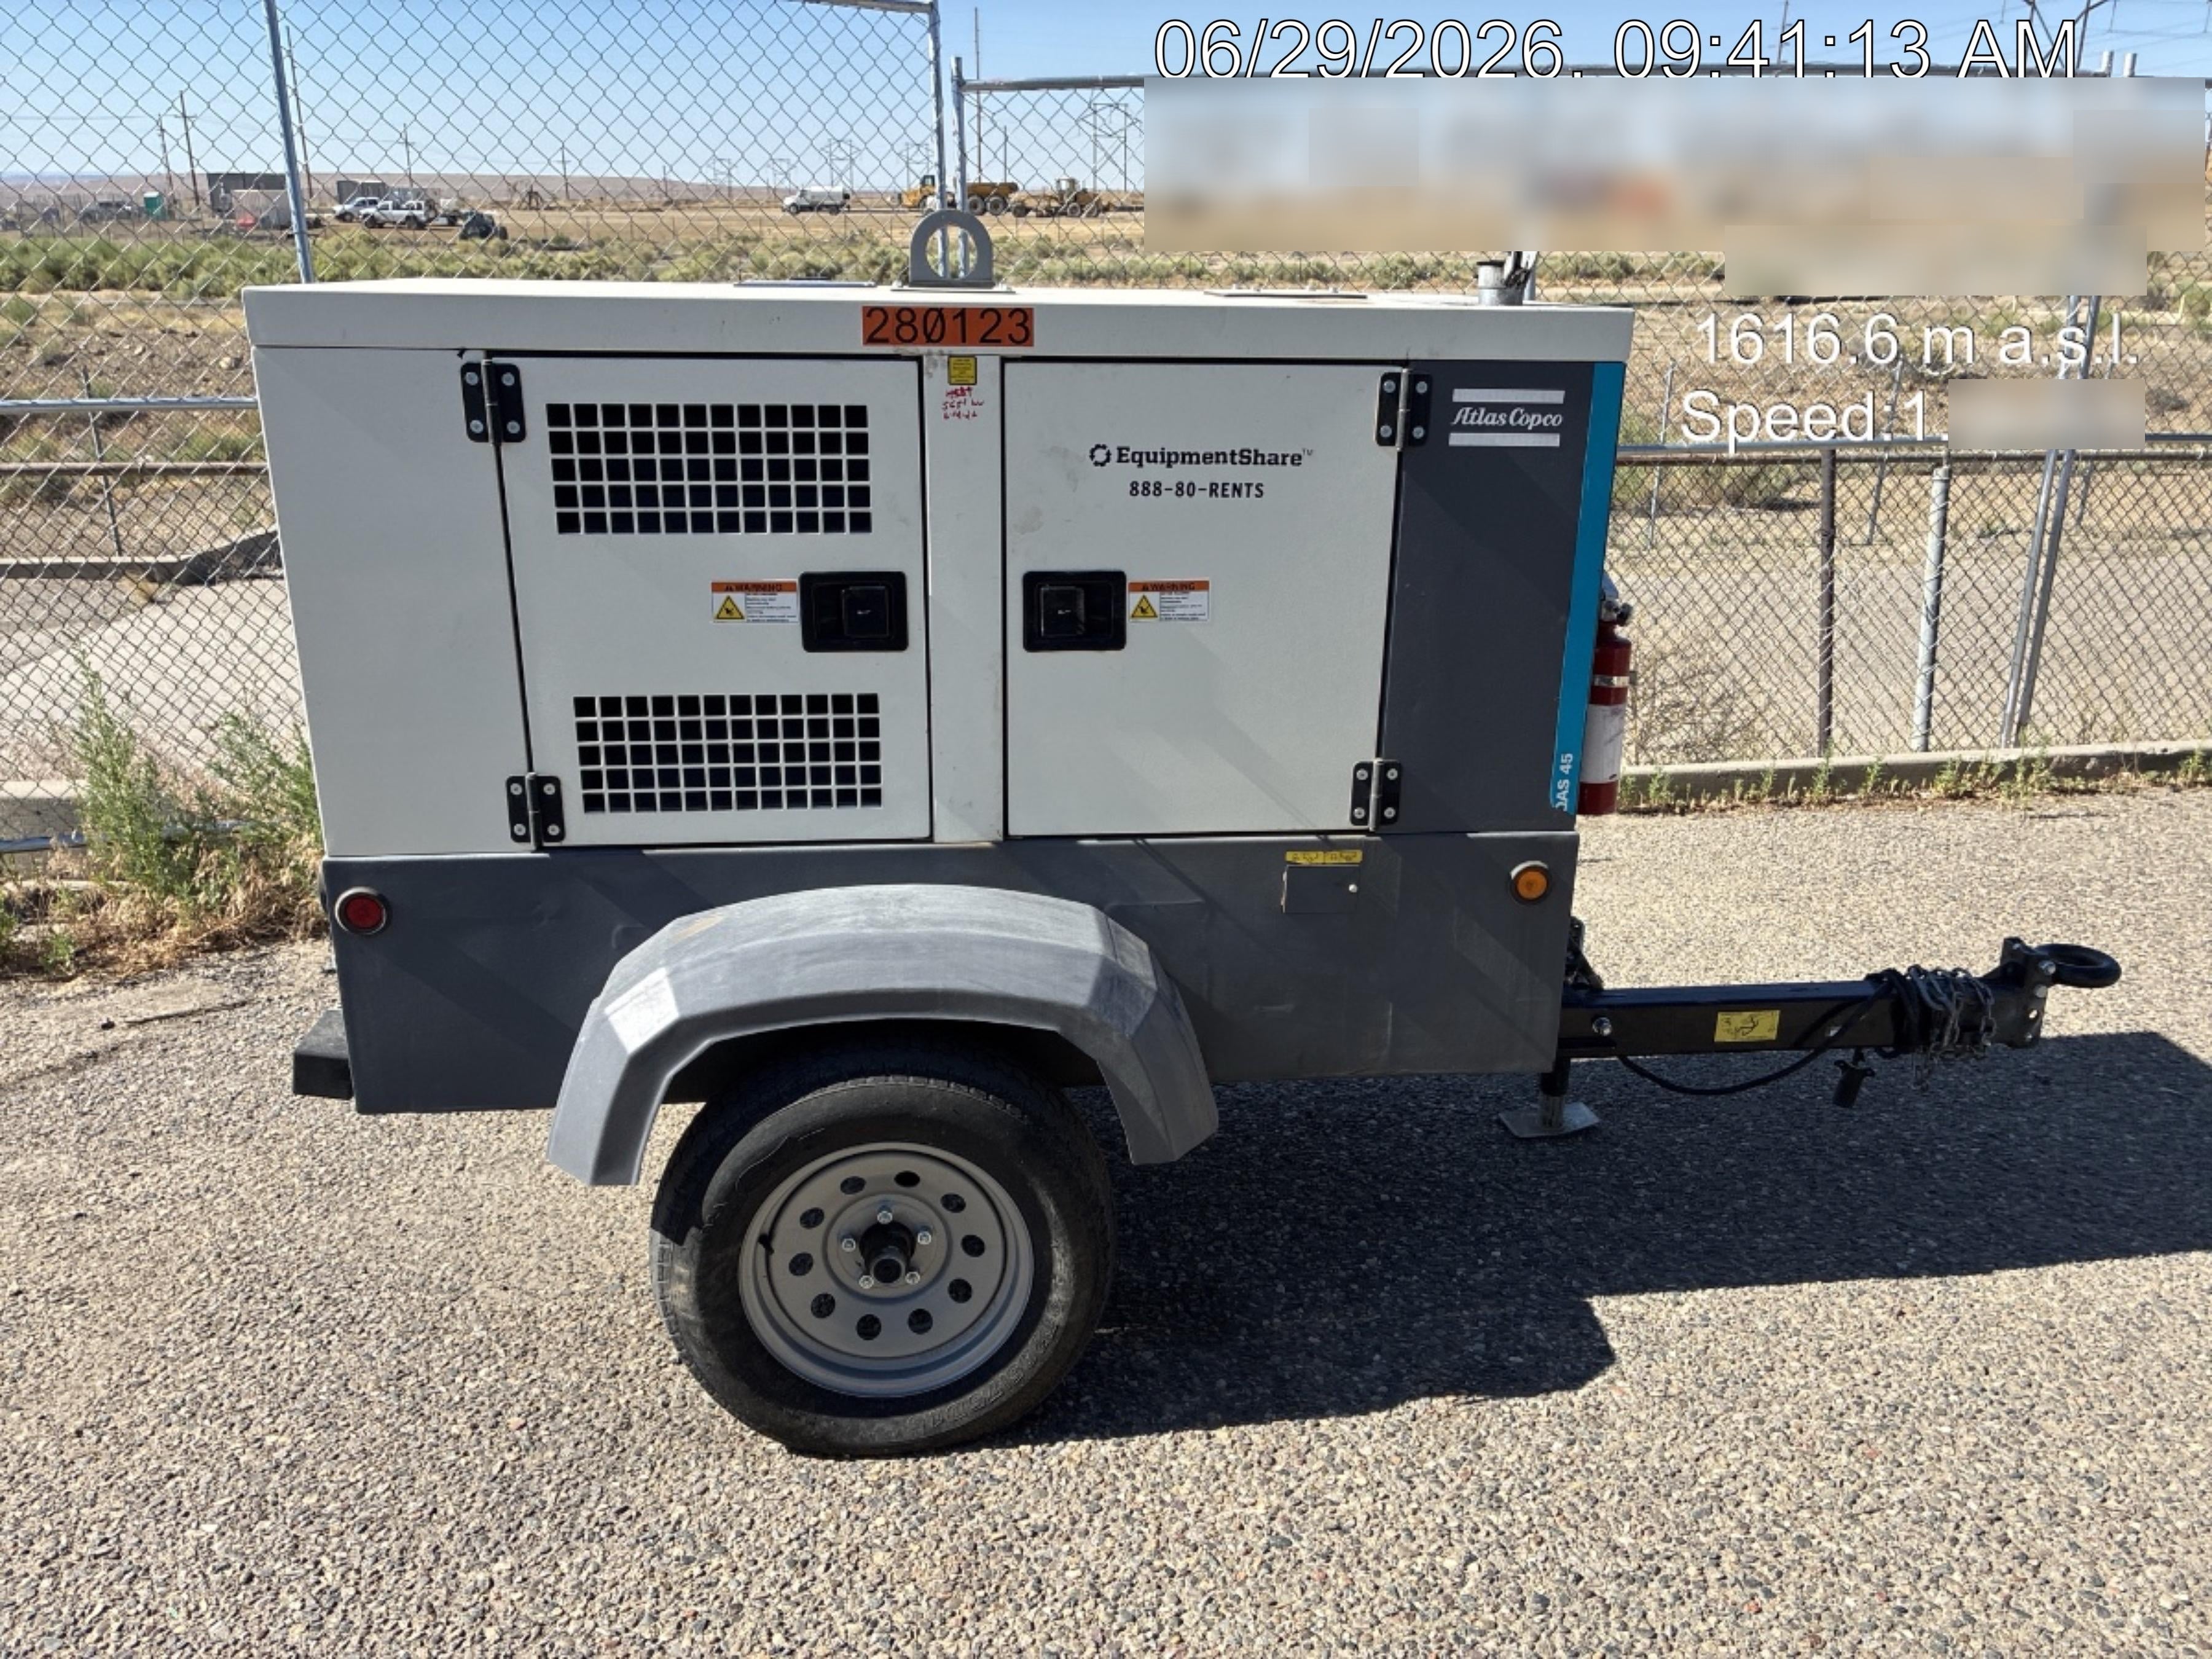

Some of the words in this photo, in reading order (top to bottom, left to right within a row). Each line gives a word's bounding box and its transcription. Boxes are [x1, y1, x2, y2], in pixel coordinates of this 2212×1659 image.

[866, 307, 1030, 343] 280123
[1451, 407, 1507, 425] Atlas
[1509, 407, 1563, 430] Copco
[1129, 480, 1265, 498] 888-80-RENTS
[1559, 753, 1574, 775] 45
